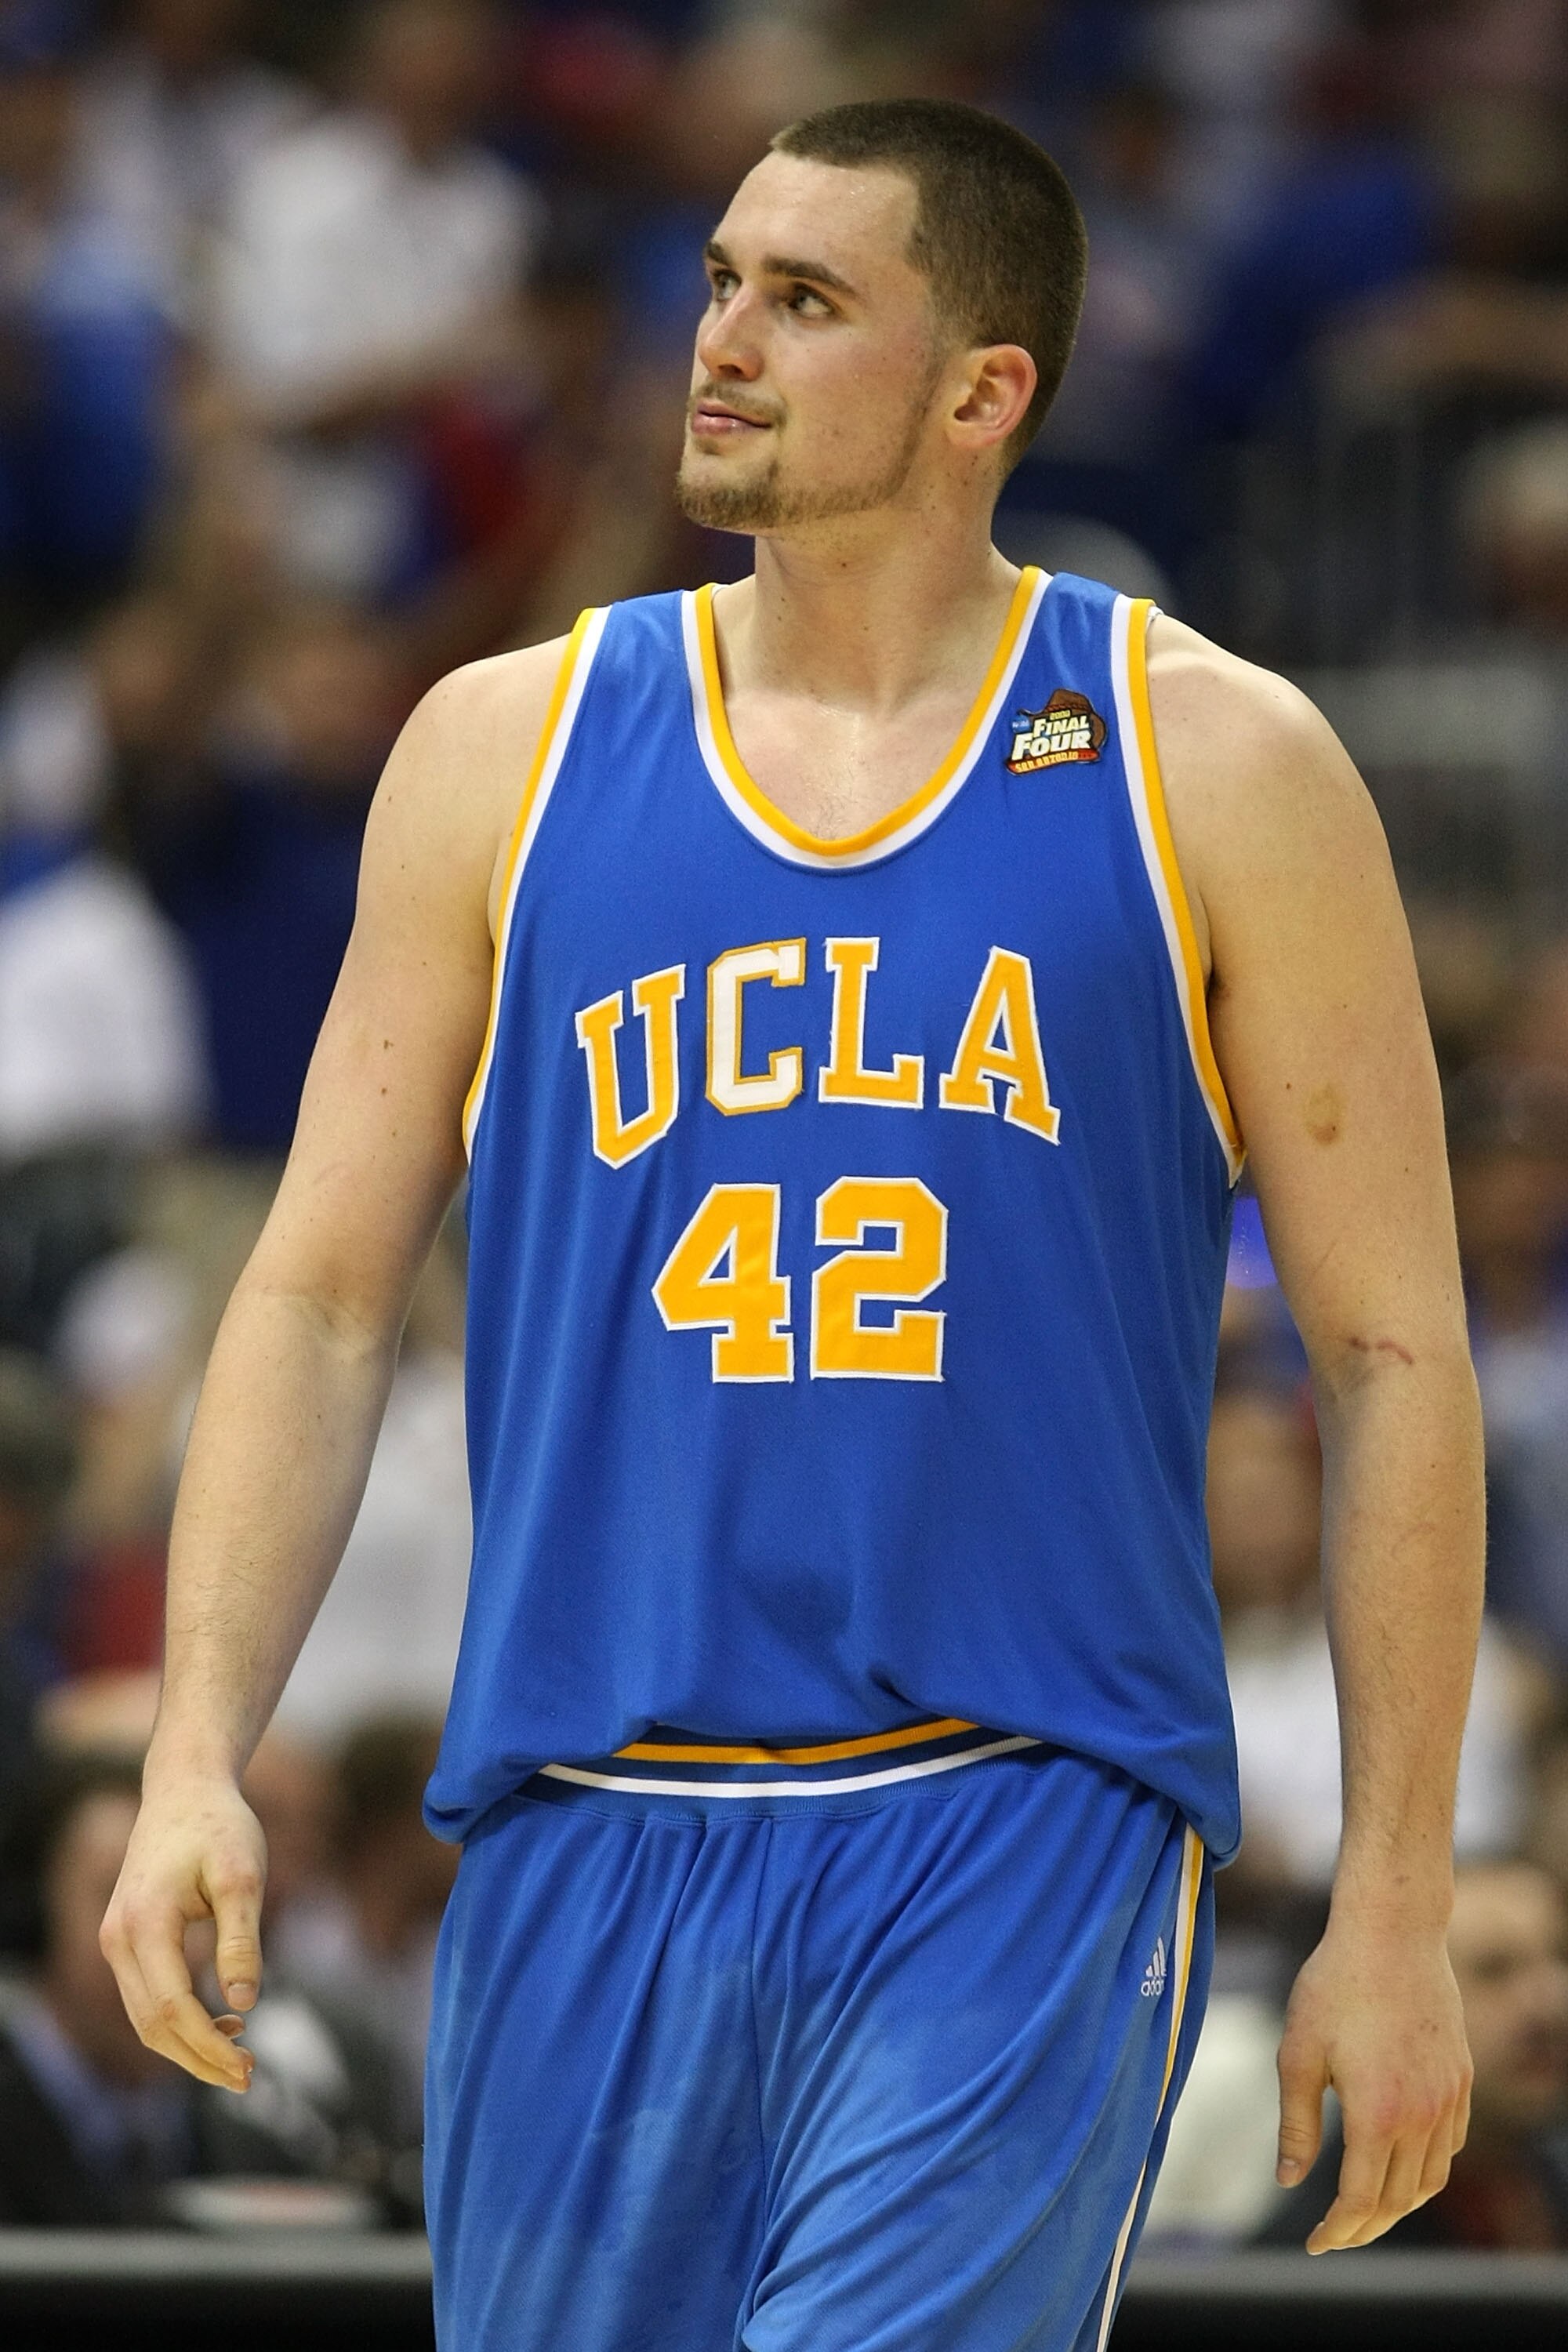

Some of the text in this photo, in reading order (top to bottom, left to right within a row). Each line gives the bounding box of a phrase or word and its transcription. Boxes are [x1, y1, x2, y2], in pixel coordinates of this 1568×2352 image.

[1011, 730, 1091, 761] FOUR
[1033, 715, 1090, 739] FINAL
[575, 937, 1061, 1170] UCLA
[652, 1176, 949, 1383] 42
